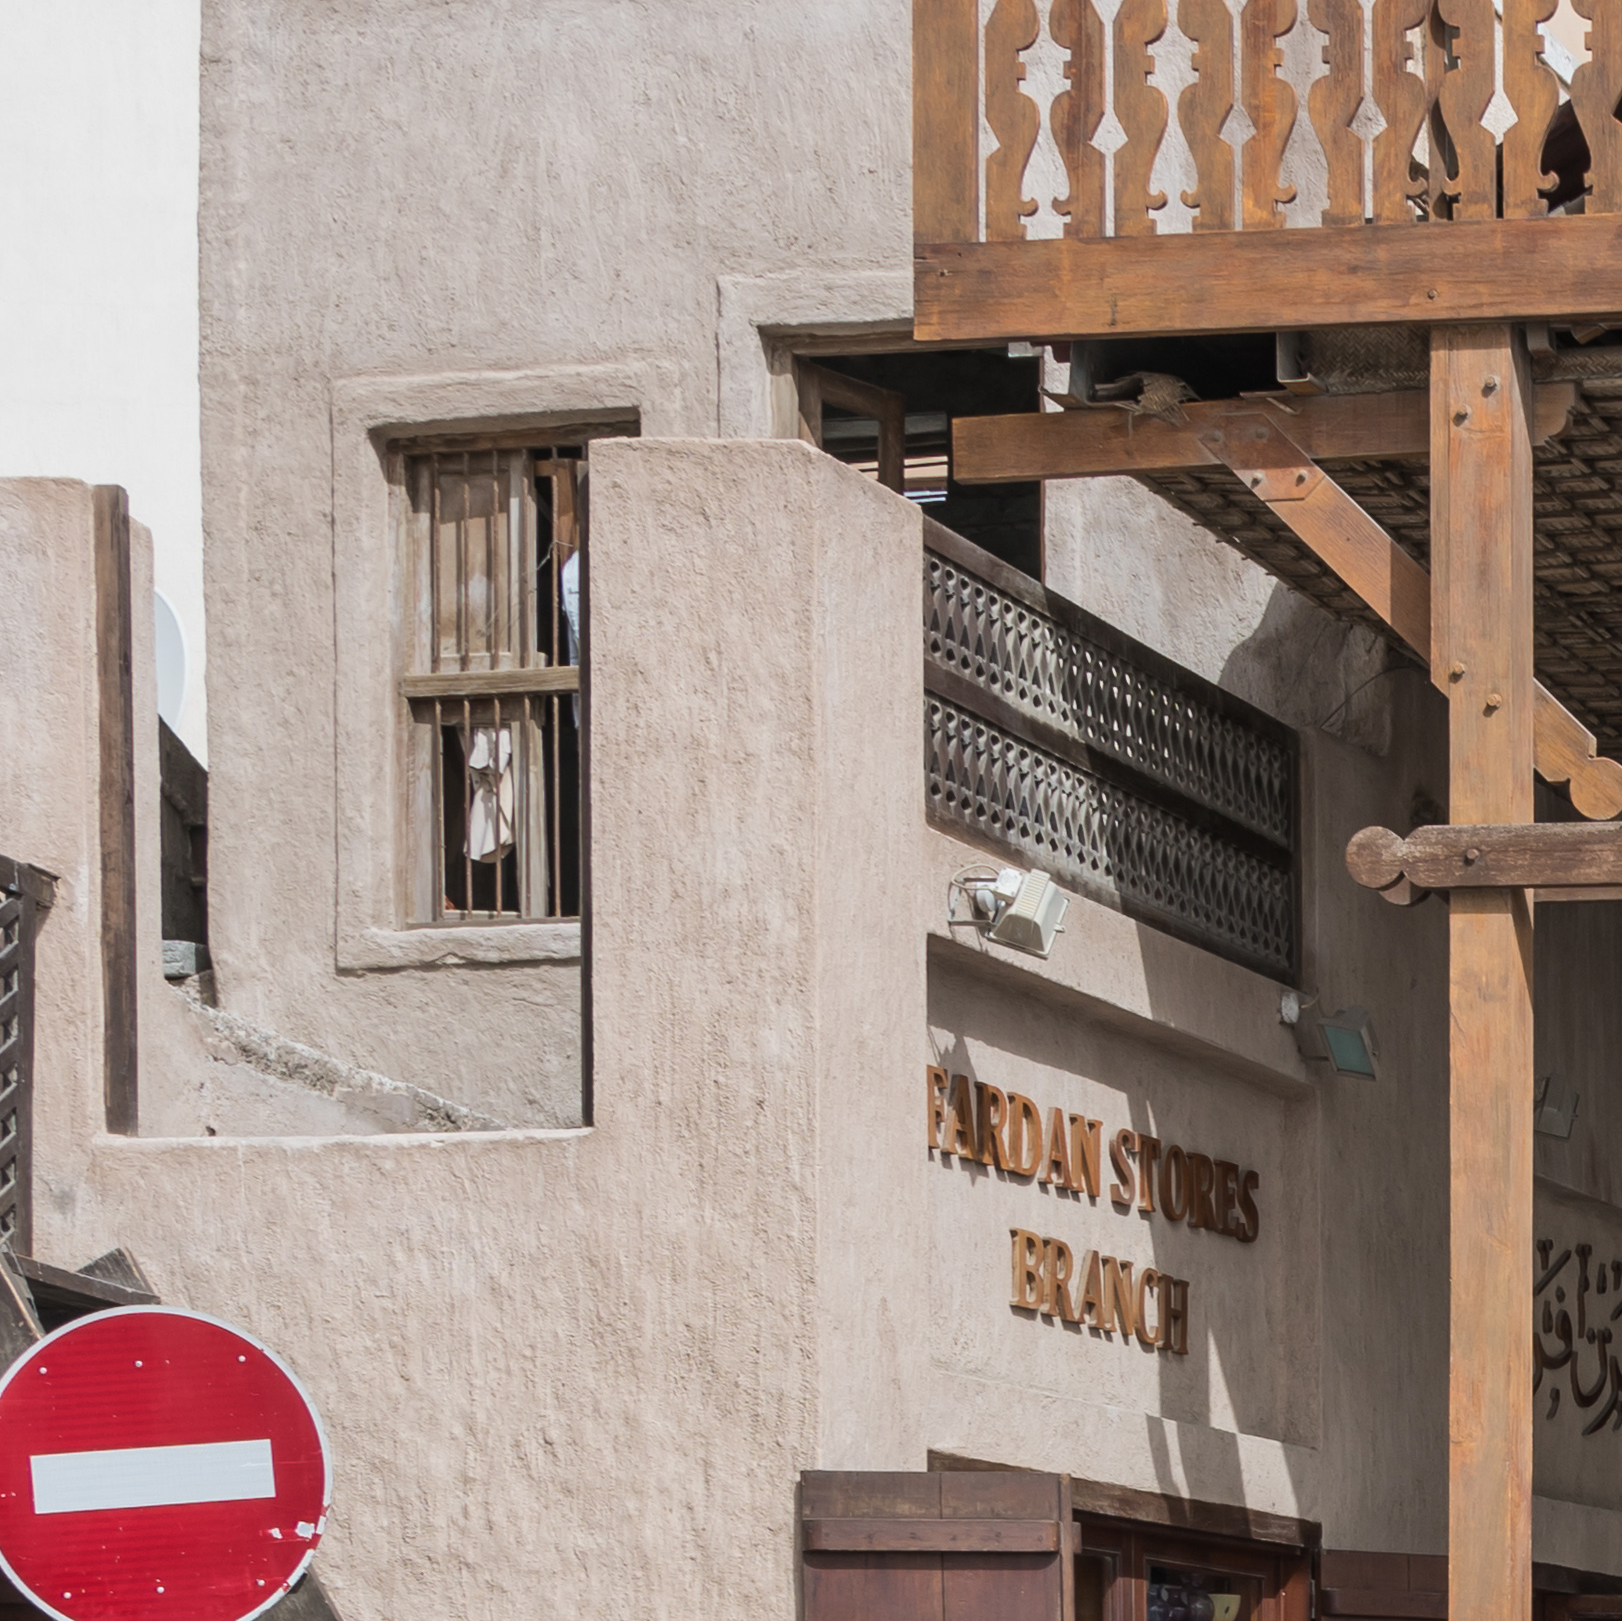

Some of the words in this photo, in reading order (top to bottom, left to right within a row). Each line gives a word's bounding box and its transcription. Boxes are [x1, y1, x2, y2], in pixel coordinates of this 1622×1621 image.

[926, 1064, 1105, 1199] FARDAN
[1109, 1127, 1261, 1244] STORES
[1008, 1227, 1191, 1357] BRANCH
